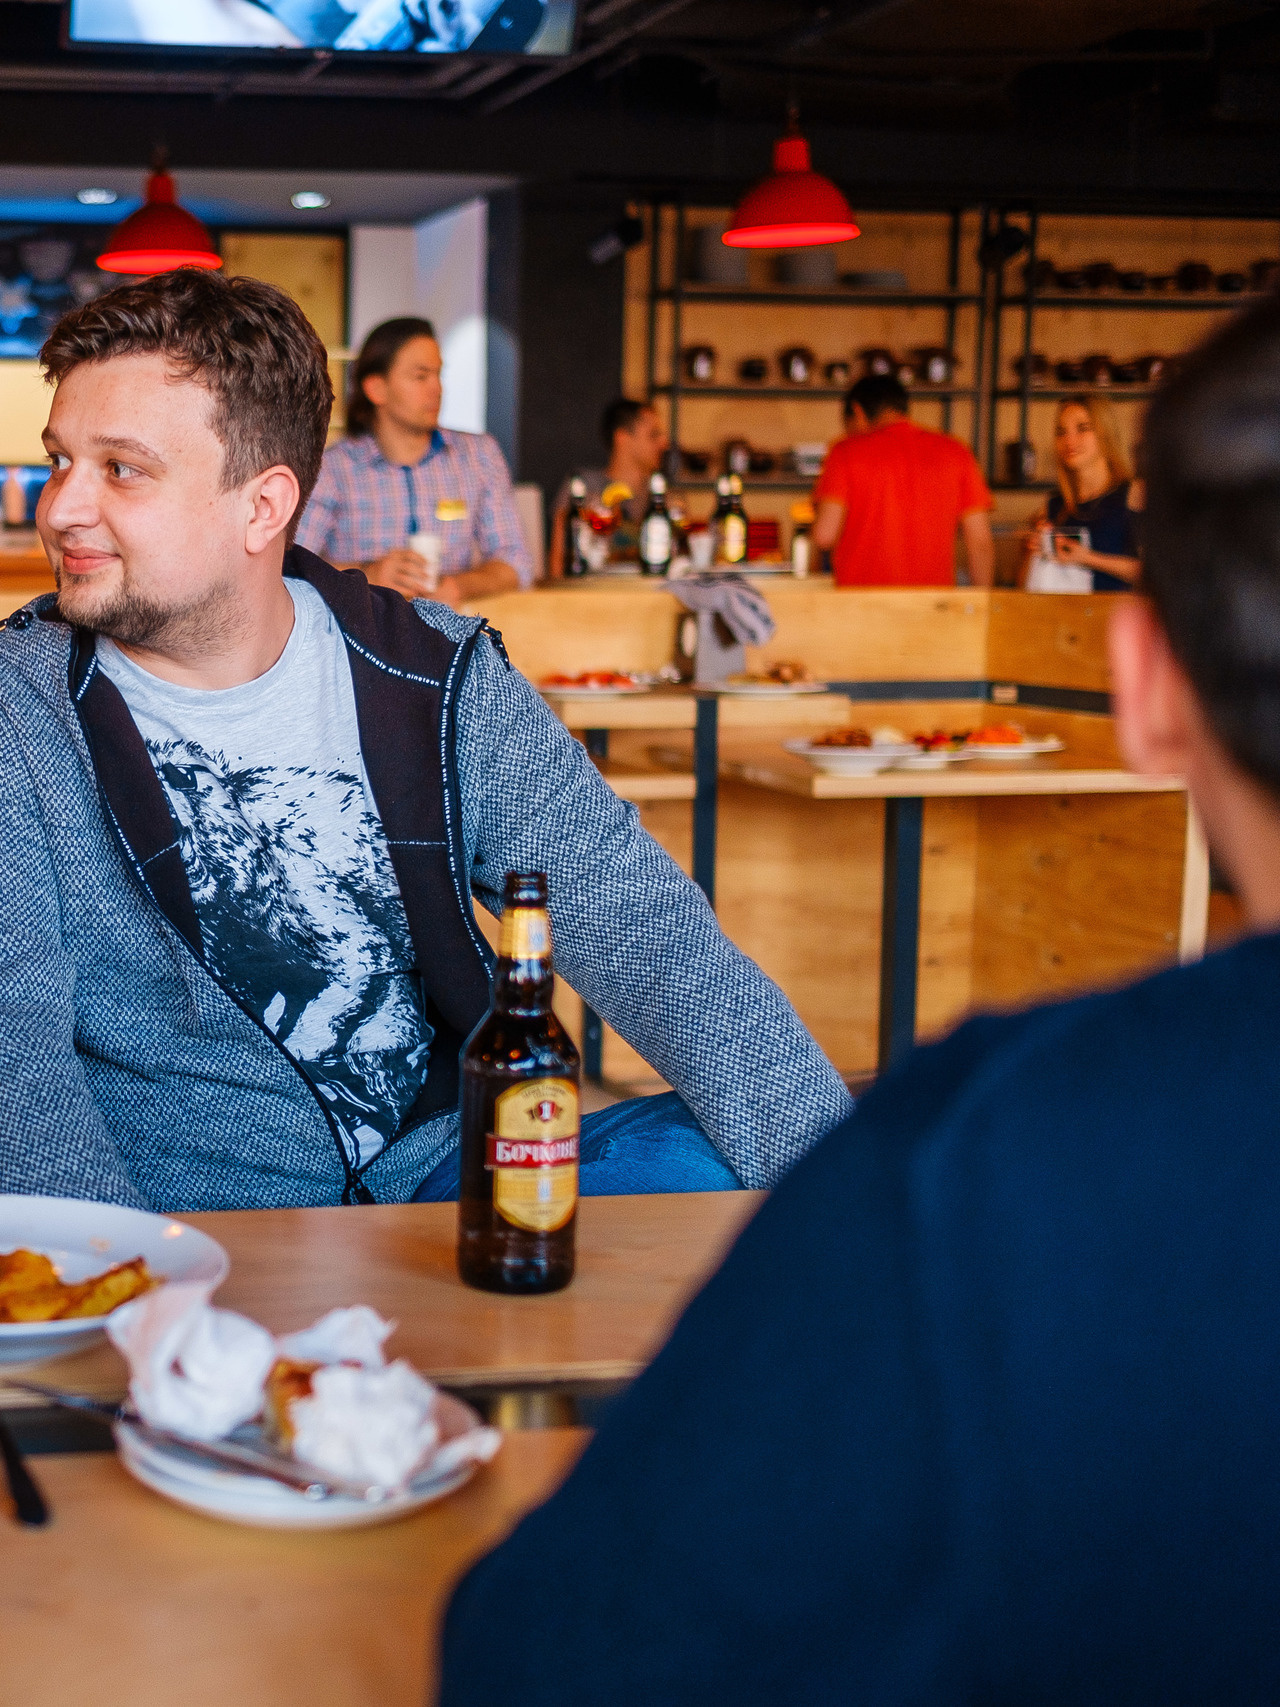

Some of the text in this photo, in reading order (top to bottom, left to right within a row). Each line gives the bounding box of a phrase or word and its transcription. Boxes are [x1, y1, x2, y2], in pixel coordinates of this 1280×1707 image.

[365, 653, 386, 670] ninety
[388, 667, 404, 677] one.
[406, 672, 440, 687] nineteen
[76, 676, 90, 700] ineteen
[441, 708, 449, 738] nineteen
